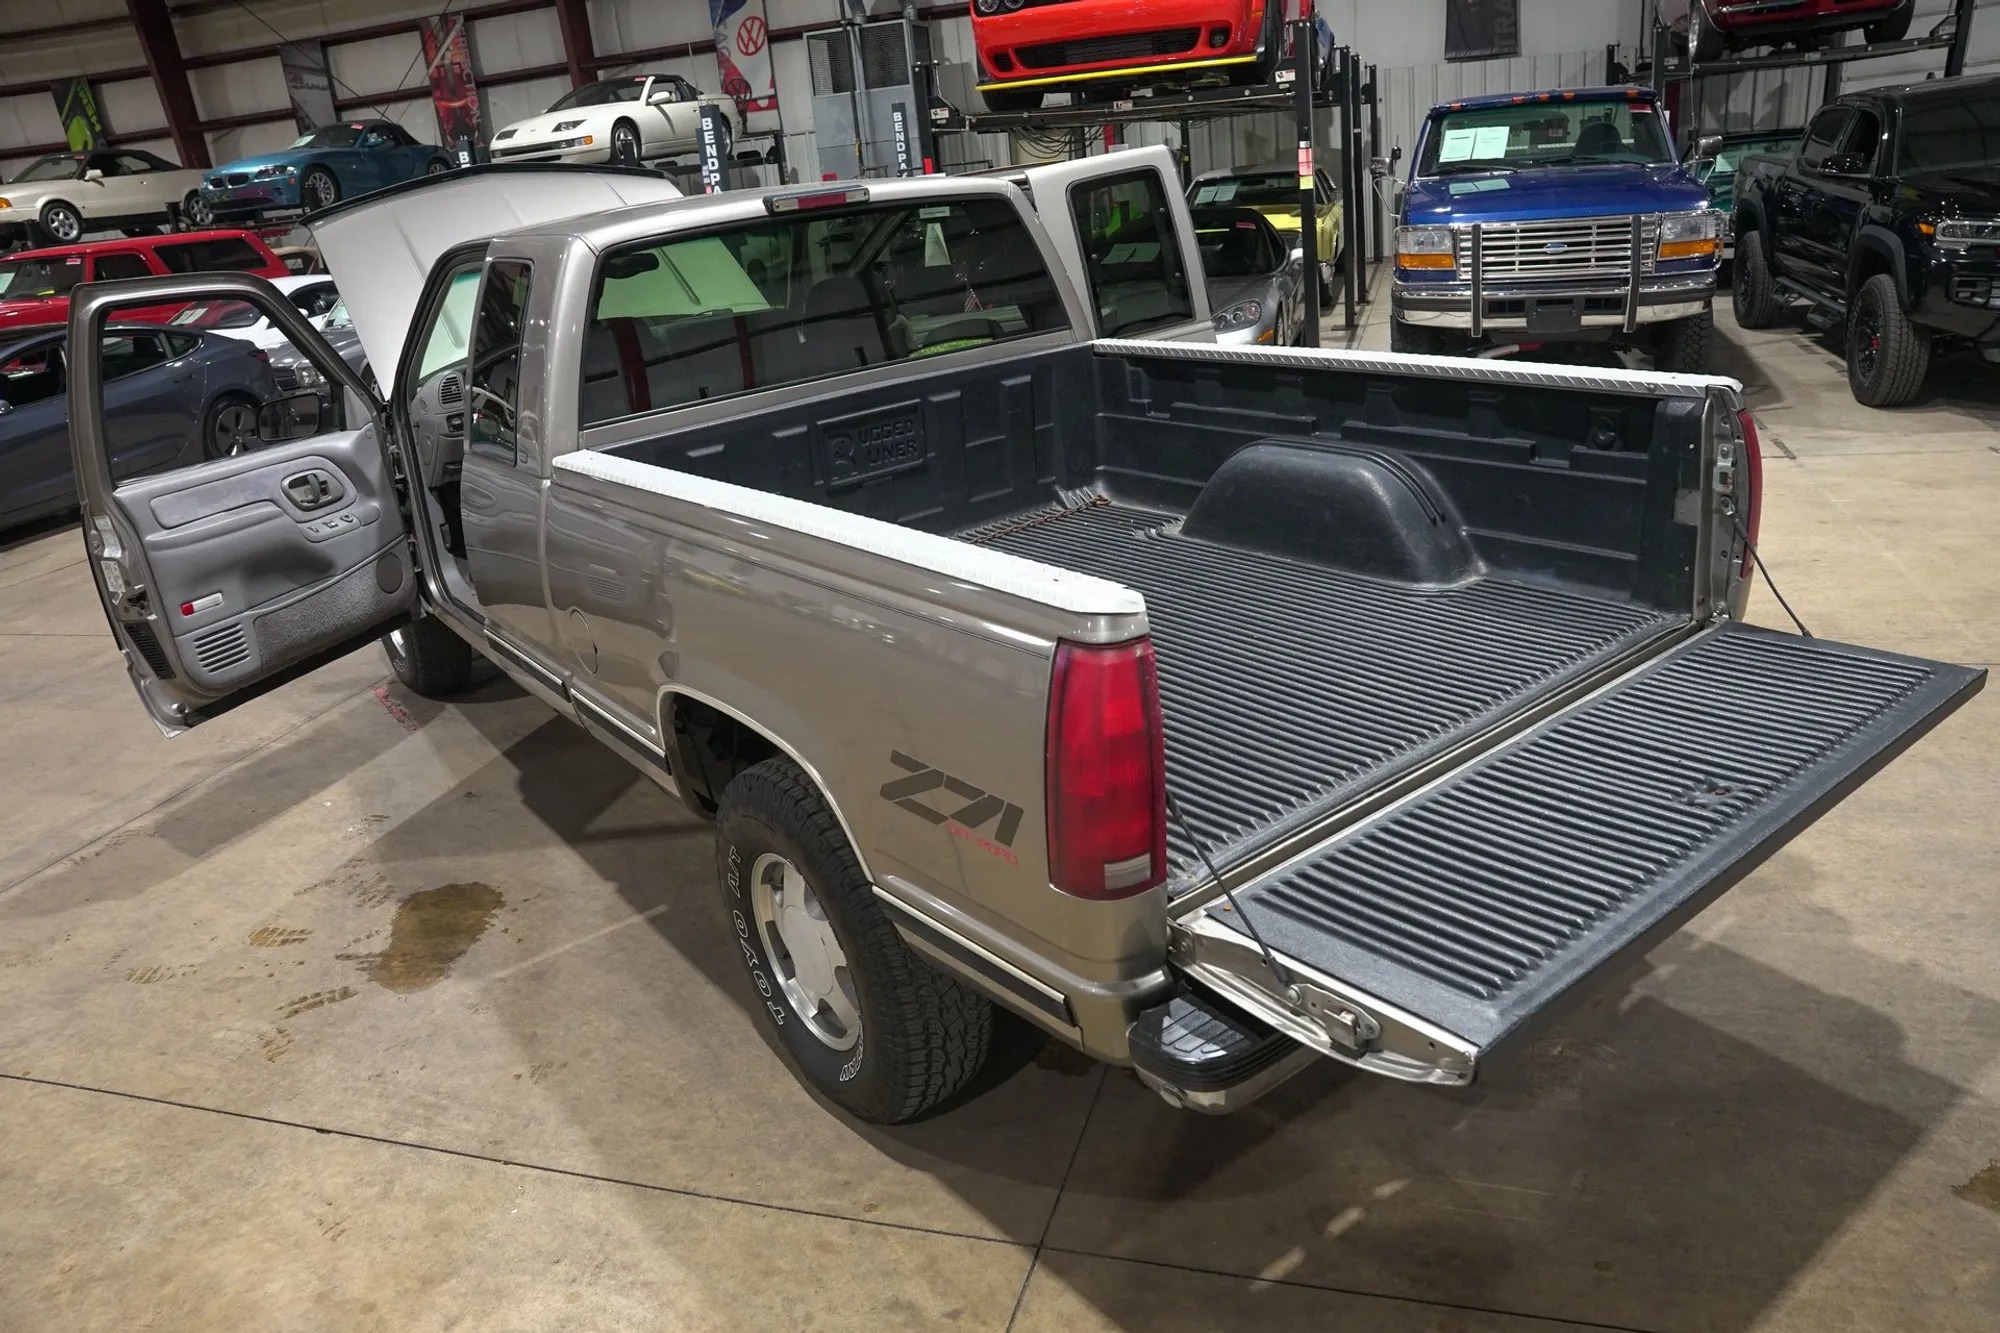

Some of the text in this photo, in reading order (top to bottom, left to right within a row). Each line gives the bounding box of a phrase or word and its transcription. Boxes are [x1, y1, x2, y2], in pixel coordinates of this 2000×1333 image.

[879, 749, 1025, 848] Z71
[727, 845, 786, 1027] TOYO A/T
